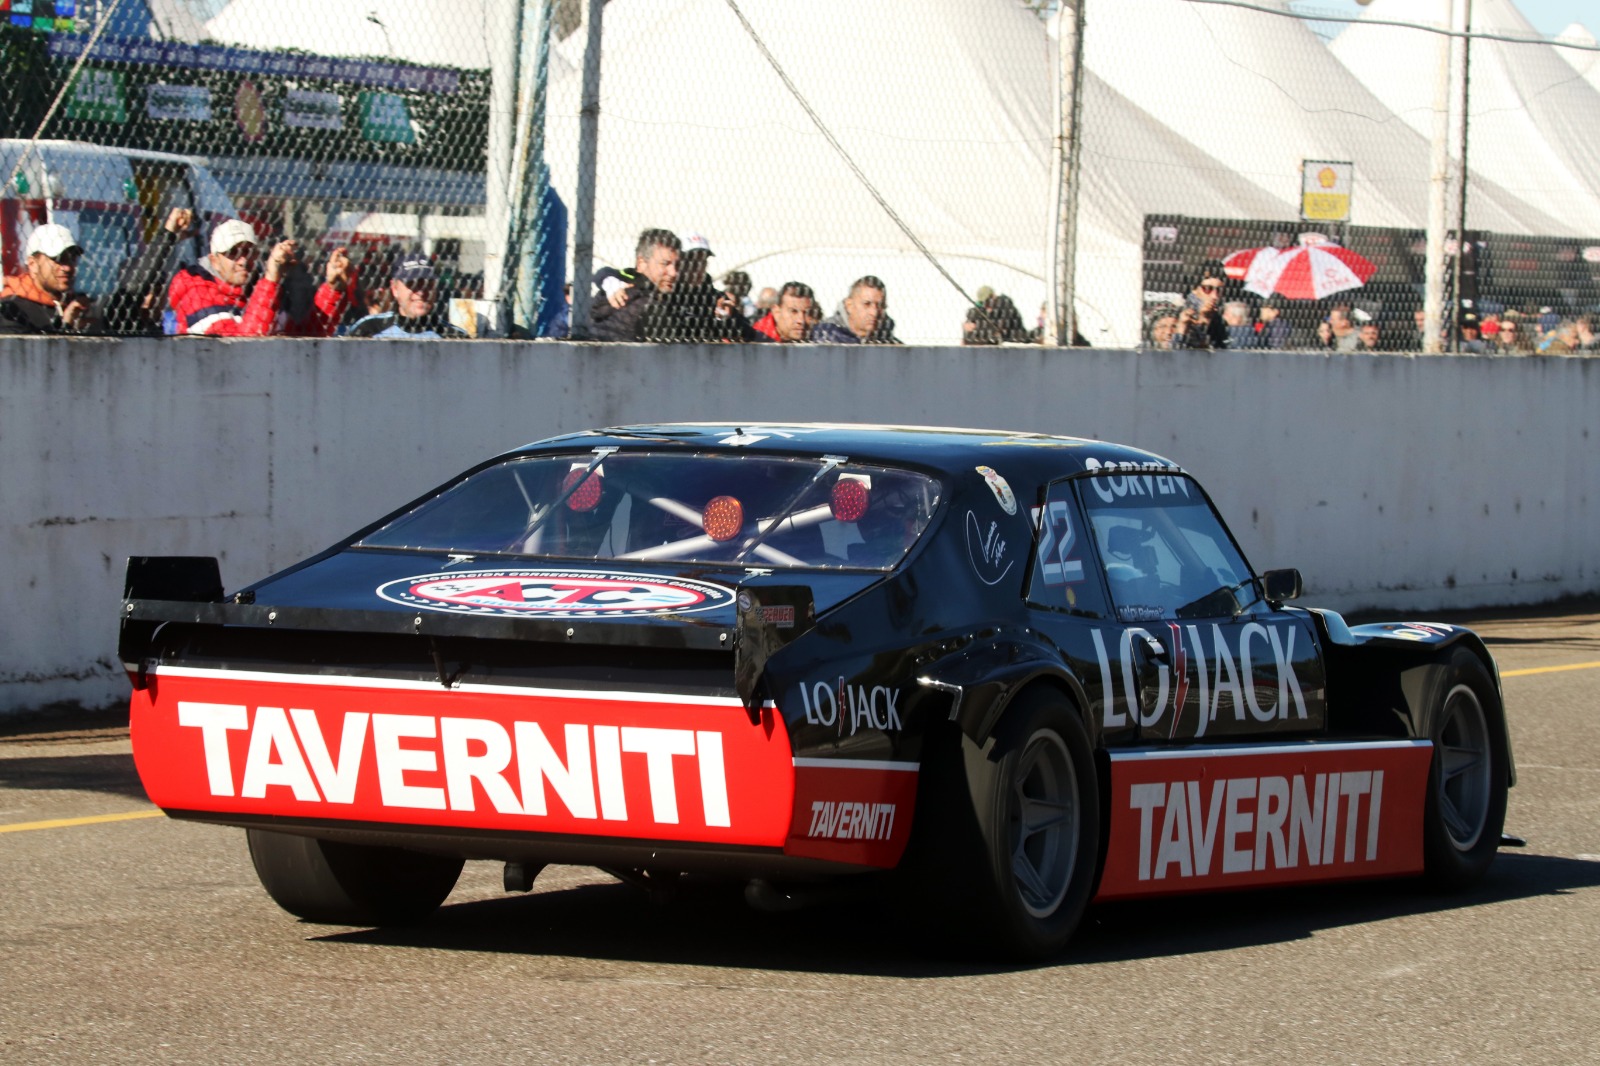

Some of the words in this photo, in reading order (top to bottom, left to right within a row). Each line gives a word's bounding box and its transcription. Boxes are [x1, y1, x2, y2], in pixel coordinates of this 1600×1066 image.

[1085, 457, 1189, 503] CORVEN
[1030, 500, 1085, 585] 22
[410, 571, 505, 584] ASOCIACION
[508, 571, 606, 580] CORREDORES
[609, 574, 669, 584] TURISMO
[447, 581, 651, 605] ACTC
[466, 597, 604, 610] ARGENTINA
[177, 700, 731, 828] TAVERNITI
[807, 801, 896, 841] TAVERNITI
[1129, 769, 1385, 882] TAVERNITI
